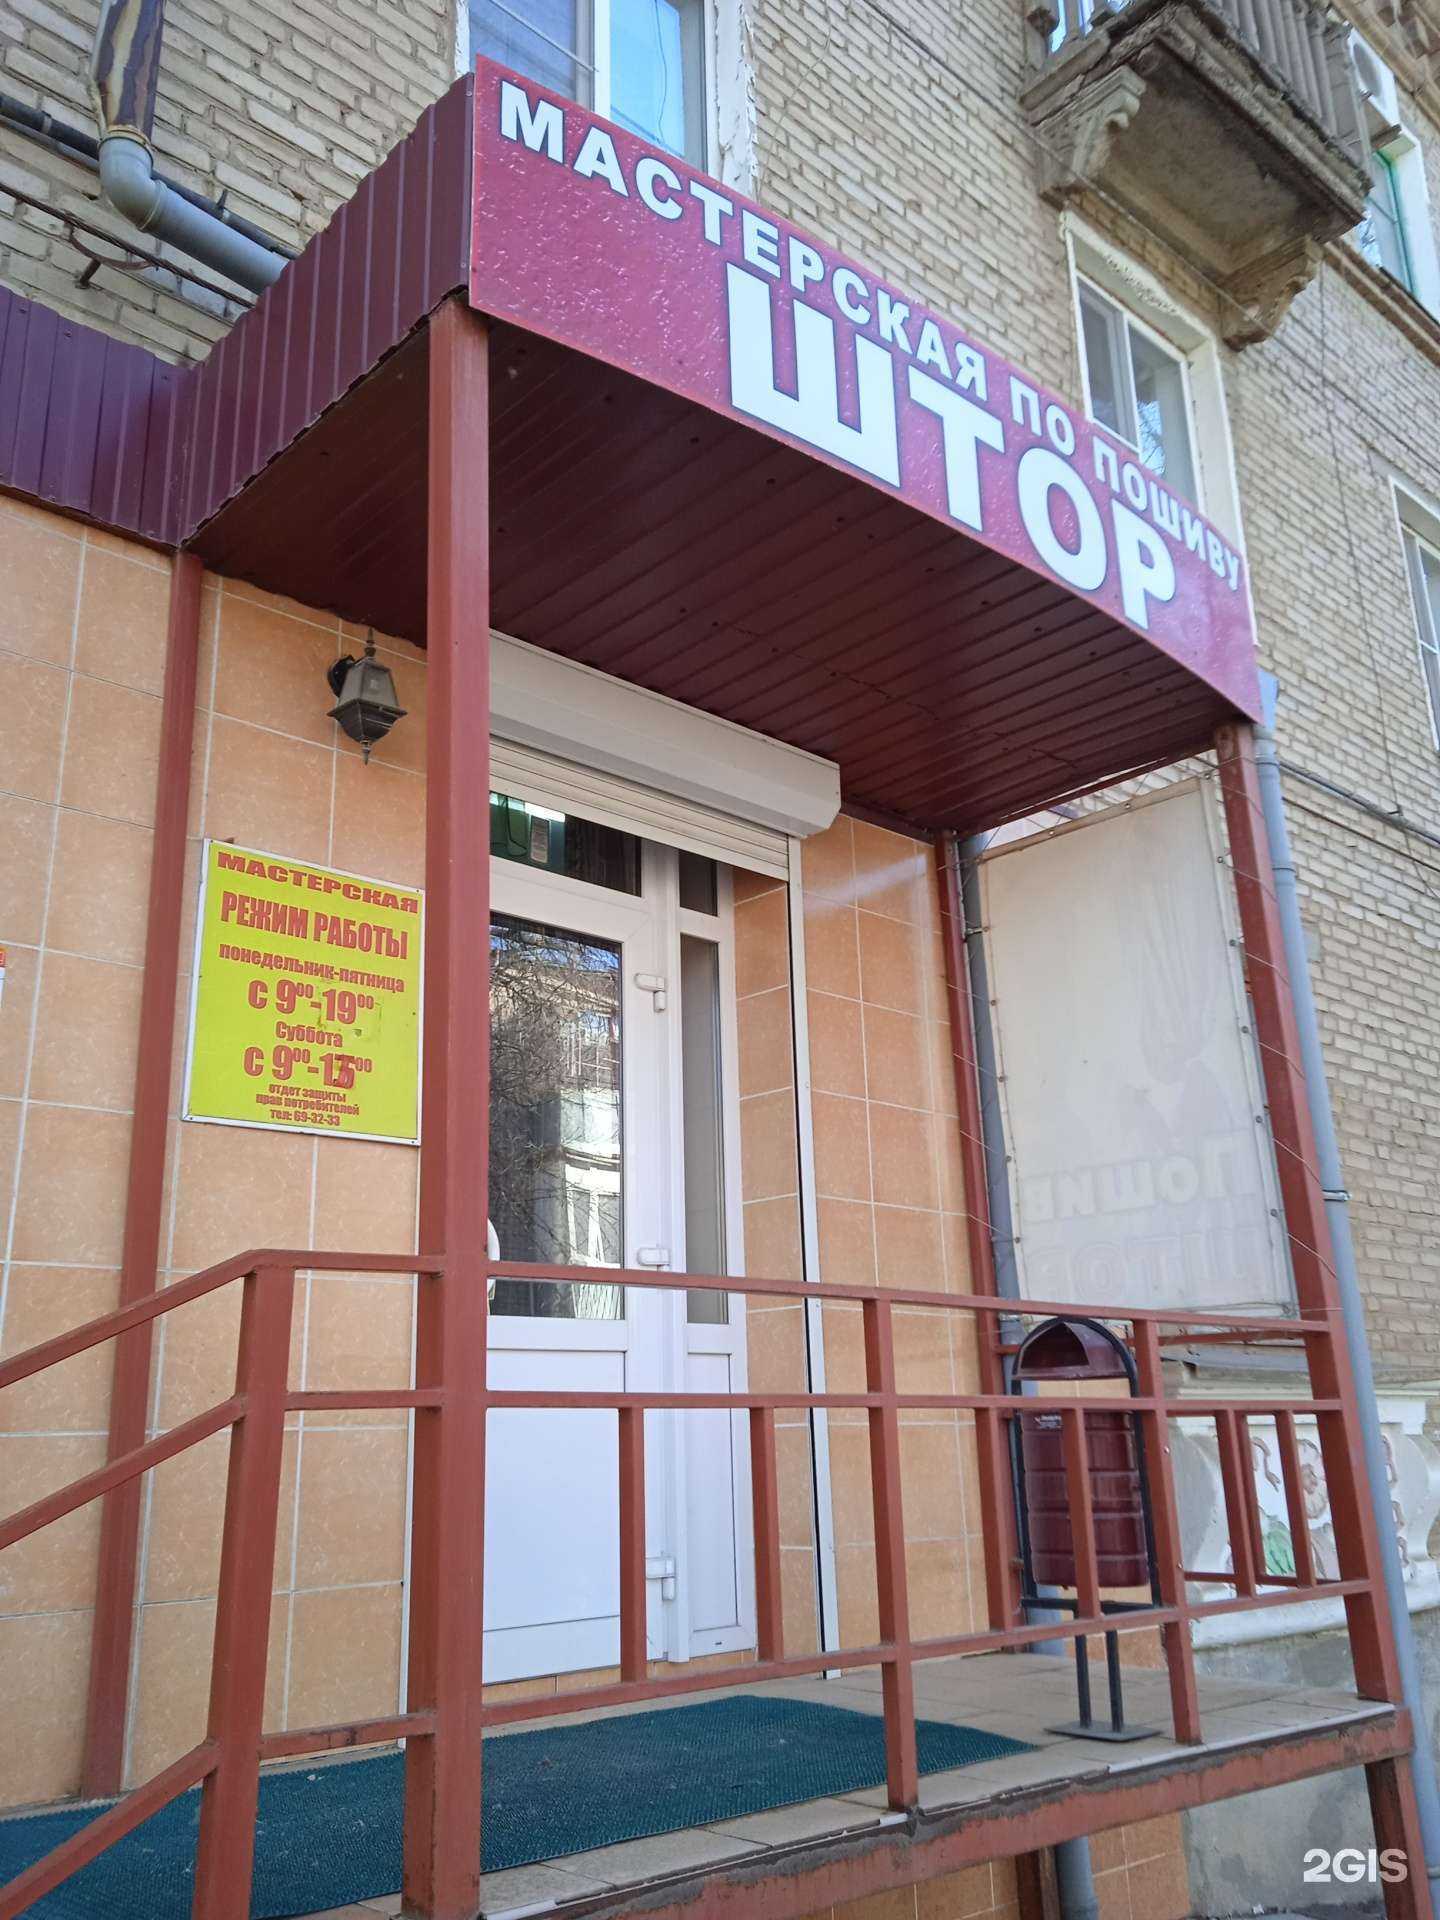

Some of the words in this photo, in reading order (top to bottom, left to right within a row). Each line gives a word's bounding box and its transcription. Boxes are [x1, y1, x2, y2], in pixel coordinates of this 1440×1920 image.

[500, 79, 988, 402] МАСТЕРСКАЯ
[1011, 373, 1076, 458] ПО
[1094, 441, 1241, 592] ПОШИВУ
[725, 262, 1176, 631] ШТОР
[217, 851, 418, 914] МАСТЕРСКАЯ
[220, 890, 309, 939] РЕЖИМ
[313, 912, 408, 960] РАБОТЫ
[276, 1021, 343, 1047] Суббота
